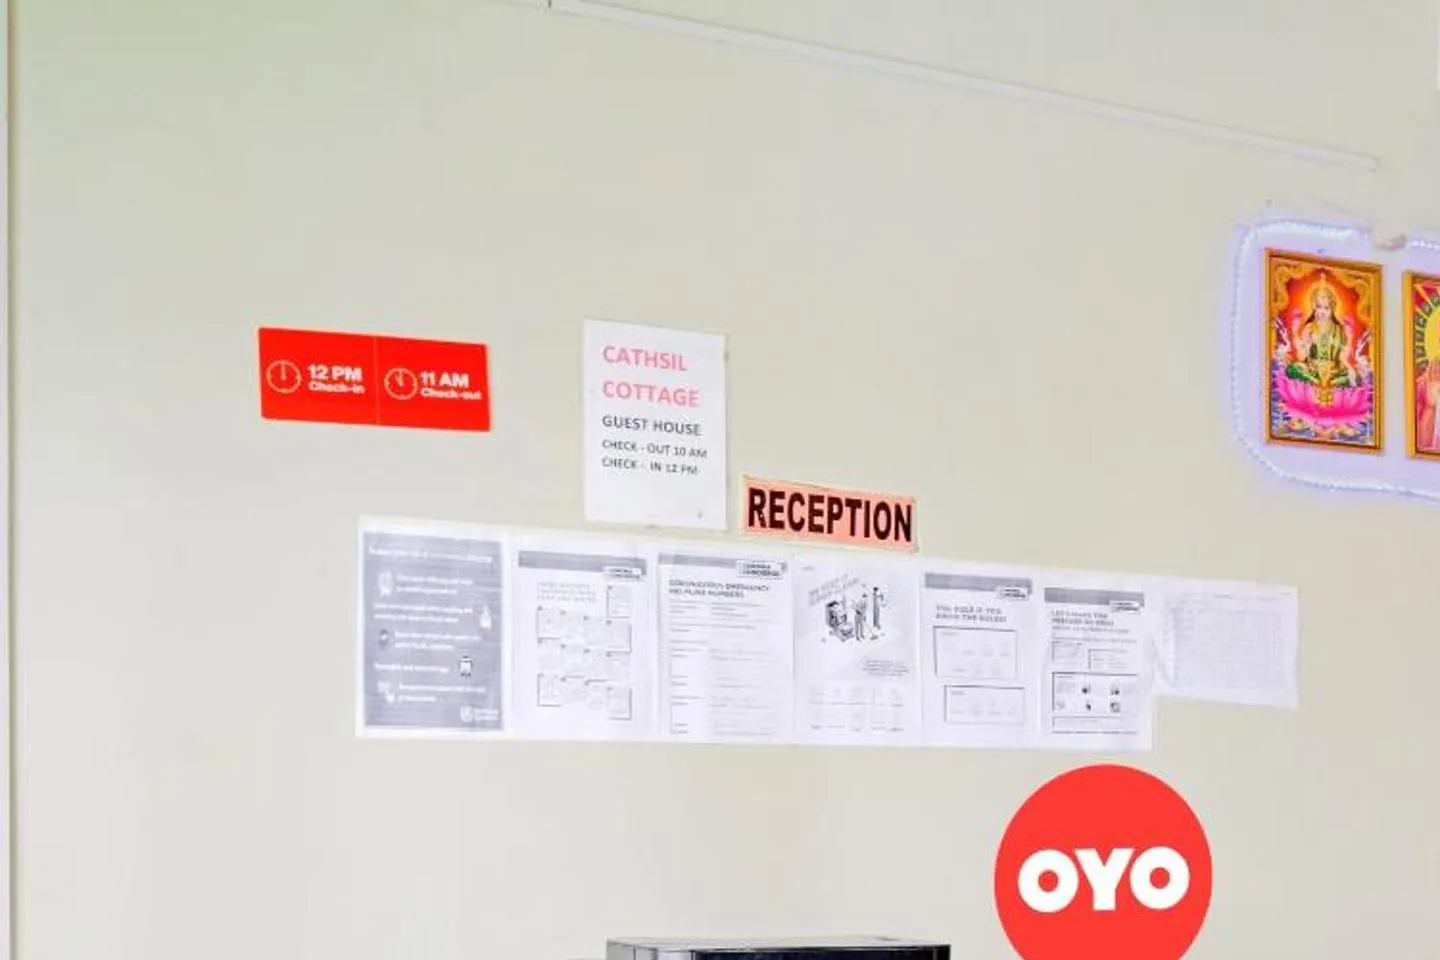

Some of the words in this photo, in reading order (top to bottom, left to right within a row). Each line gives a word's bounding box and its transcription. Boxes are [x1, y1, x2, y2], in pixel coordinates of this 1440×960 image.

[602, 345, 688, 371] CATHSIL
[308, 364, 327, 380] 12
[332, 365, 362, 382] PM
[420, 371, 436, 385] 11
[440, 373, 469, 387] AM
[308, 381, 365, 394] Check-in
[420, 387, 481, 400] Check-out
[602, 380, 701, 407] COTTAGE
[602, 415, 648, 430] GUEST
[653, 420, 702, 436] HOUSE
[602, 439, 637, 451] CHECK
[647, 443, 671, 455] OUT
[674, 446, 686, 457] 10
[689, 448, 708, 458] AM
[602, 457, 637, 469] CHECK
[650, 461, 661, 472] IN
[666, 464, 677, 473] 12
[681, 464, 698, 475] PM
[748, 487, 912, 542] RECEPTION
[1017, 846, 1190, 913] OYO
